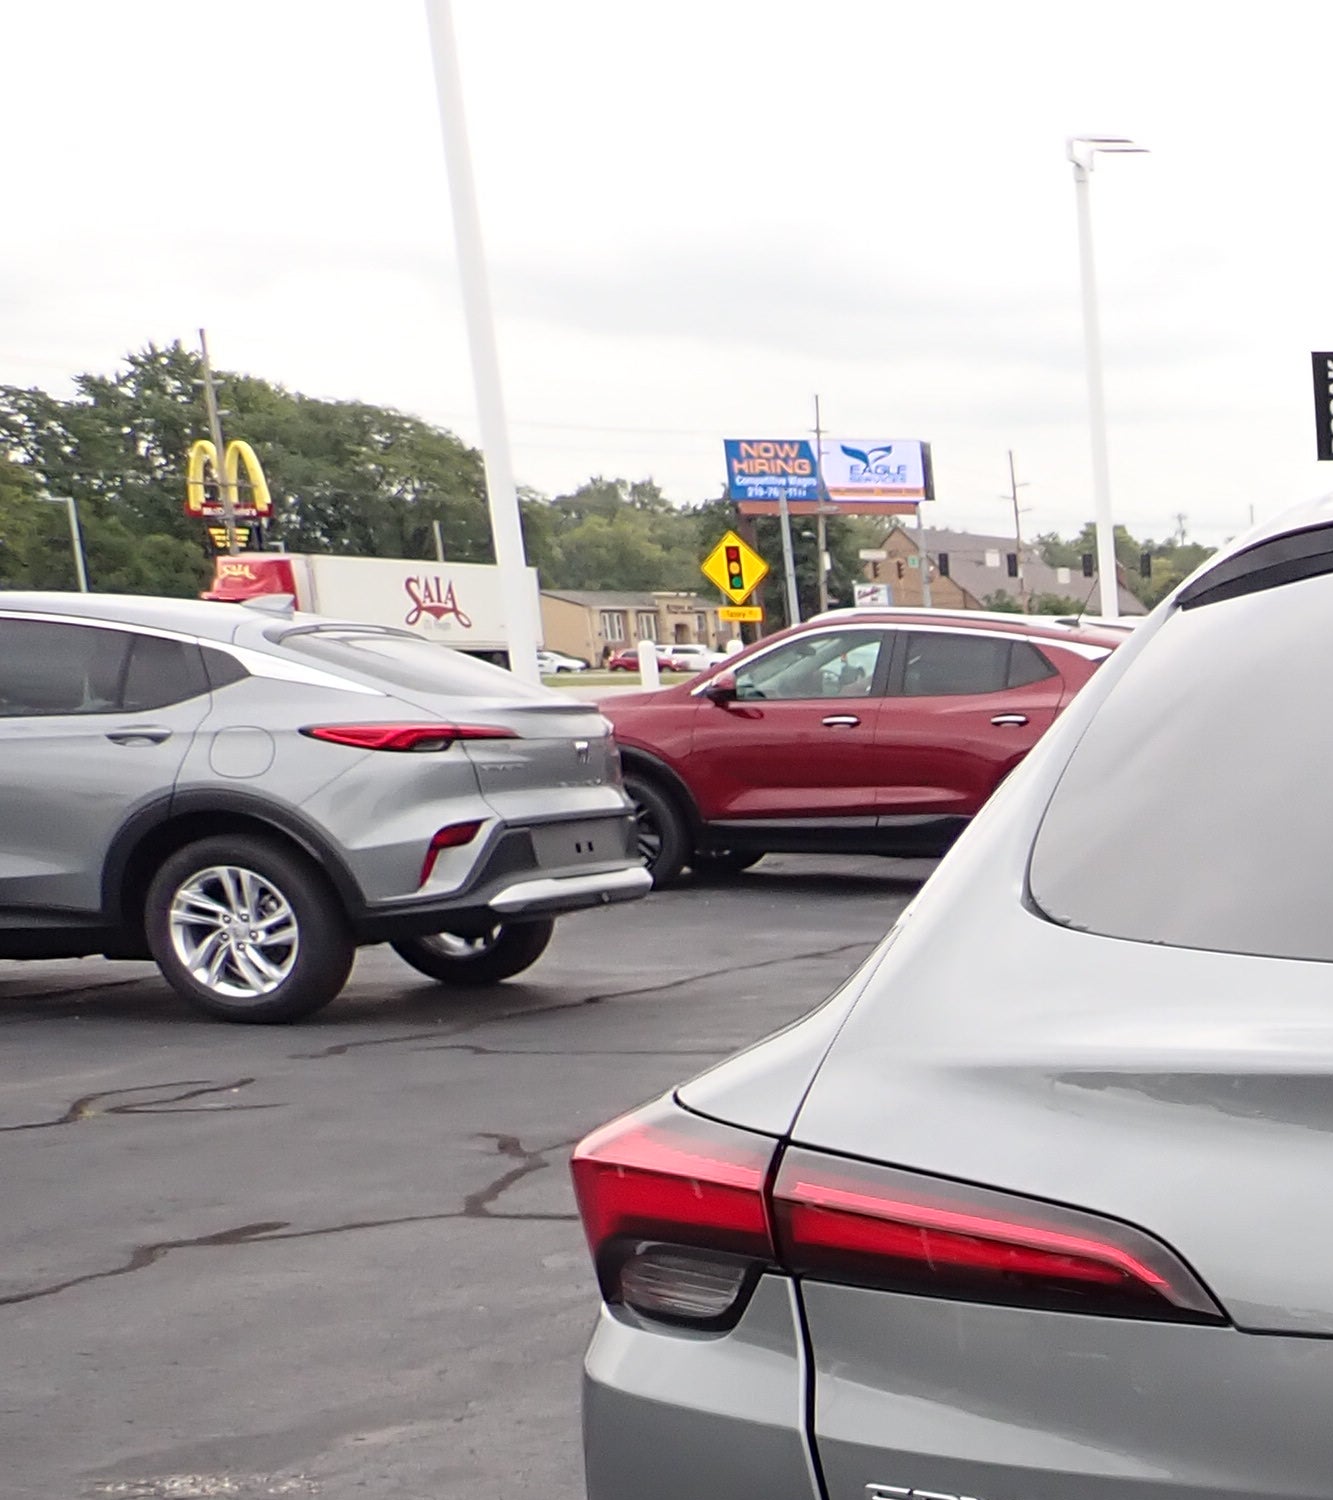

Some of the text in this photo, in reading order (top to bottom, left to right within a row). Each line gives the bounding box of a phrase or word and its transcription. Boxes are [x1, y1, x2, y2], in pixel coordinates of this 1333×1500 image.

[740, 442, 800, 459] NOW
[732, 459, 812, 475] HIRING
[849, 464, 907, 475] EAGLE
[405, 575, 472, 628] SAIA
